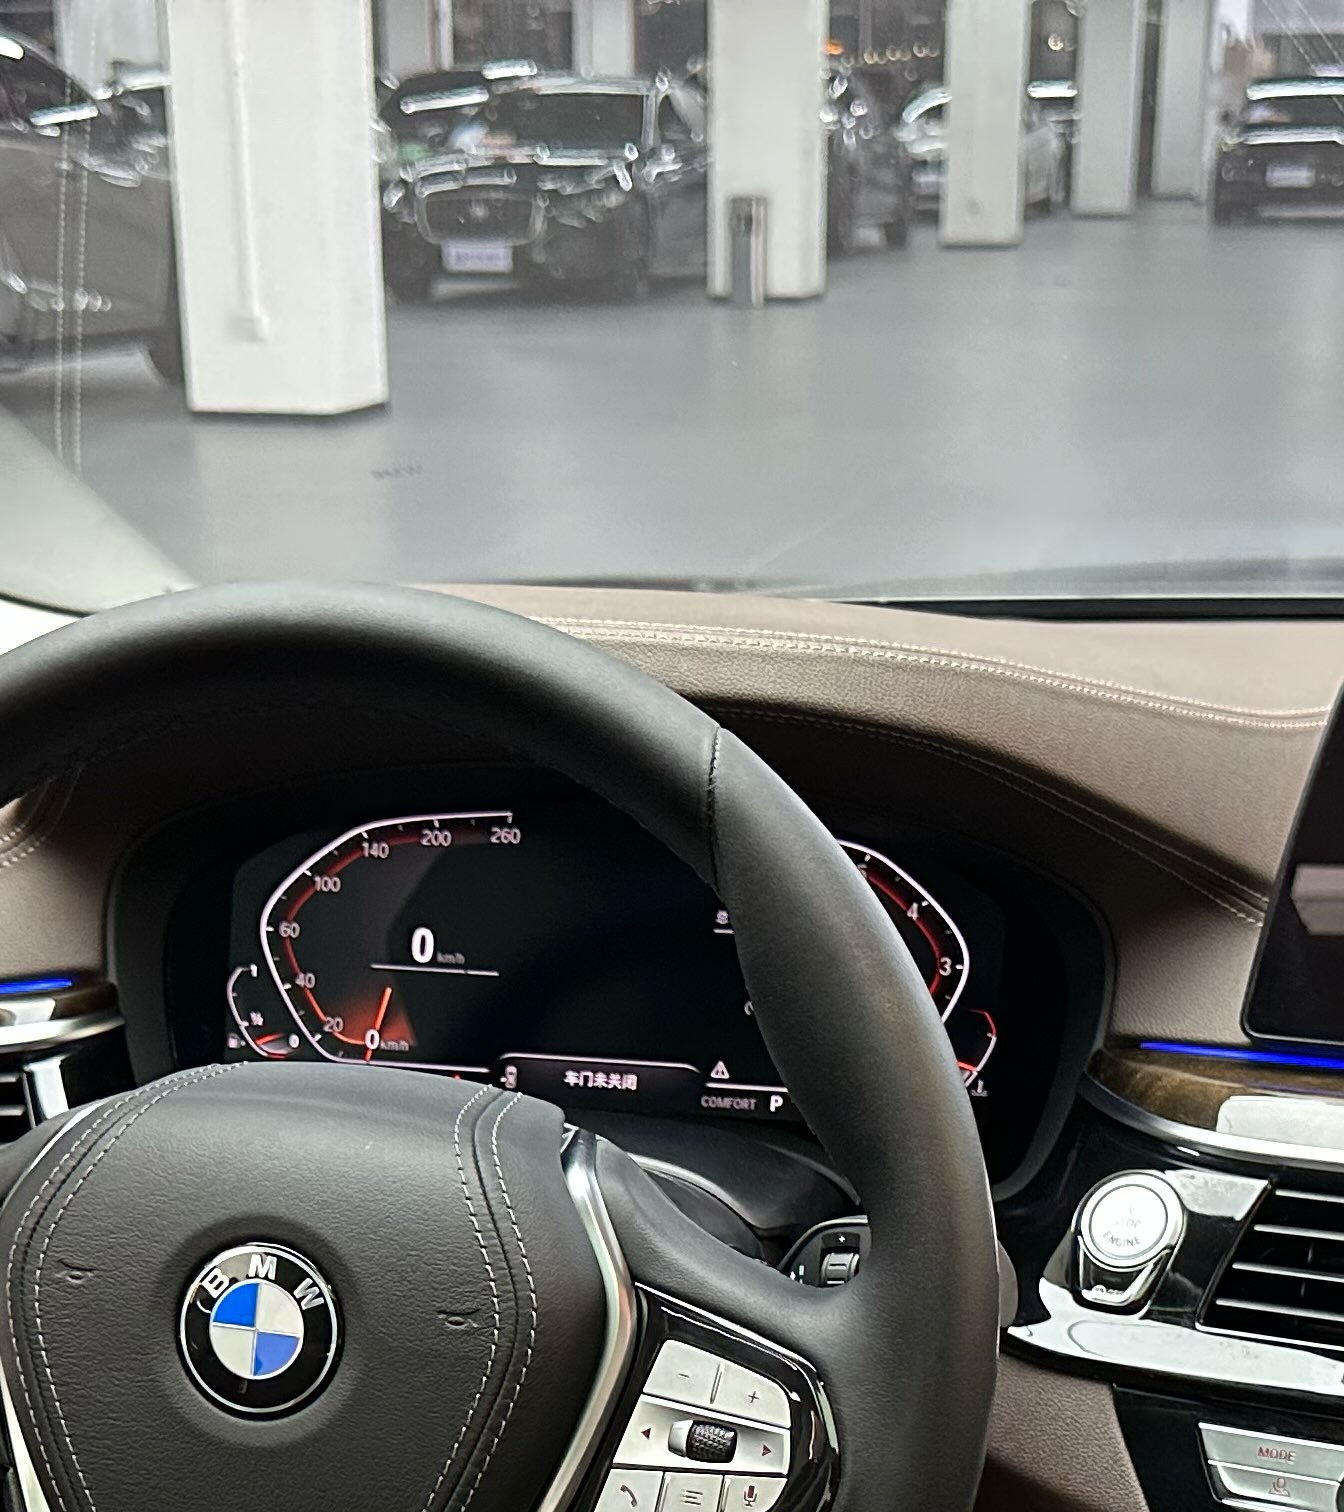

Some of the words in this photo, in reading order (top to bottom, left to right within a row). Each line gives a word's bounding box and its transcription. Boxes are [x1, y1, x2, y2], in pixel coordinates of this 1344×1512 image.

[421, 830, 452, 847] 200
[490, 827, 521, 845] 260
[362, 842, 390, 859] 140
[314, 875, 342, 893] 100
[906, 902, 919, 920] 4
[278, 922, 301, 939] 60
[411, 926, 435, 964] 0
[938, 957, 952, 976] 3
[294, 972, 316, 989] 40
[324, 1016, 344, 1033] 20
[364, 1029, 381, 1050] 0
[563, 1069, 638, 1091] 车门未关闭
[701, 1095, 757, 1111] COMFORT
[769, 1095, 784, 1112] P
[1103, 1230, 1142, 1248] ENGINE
[201, 1254, 325, 1311] BMW
[1257, 1446, 1297, 1464] MODE
